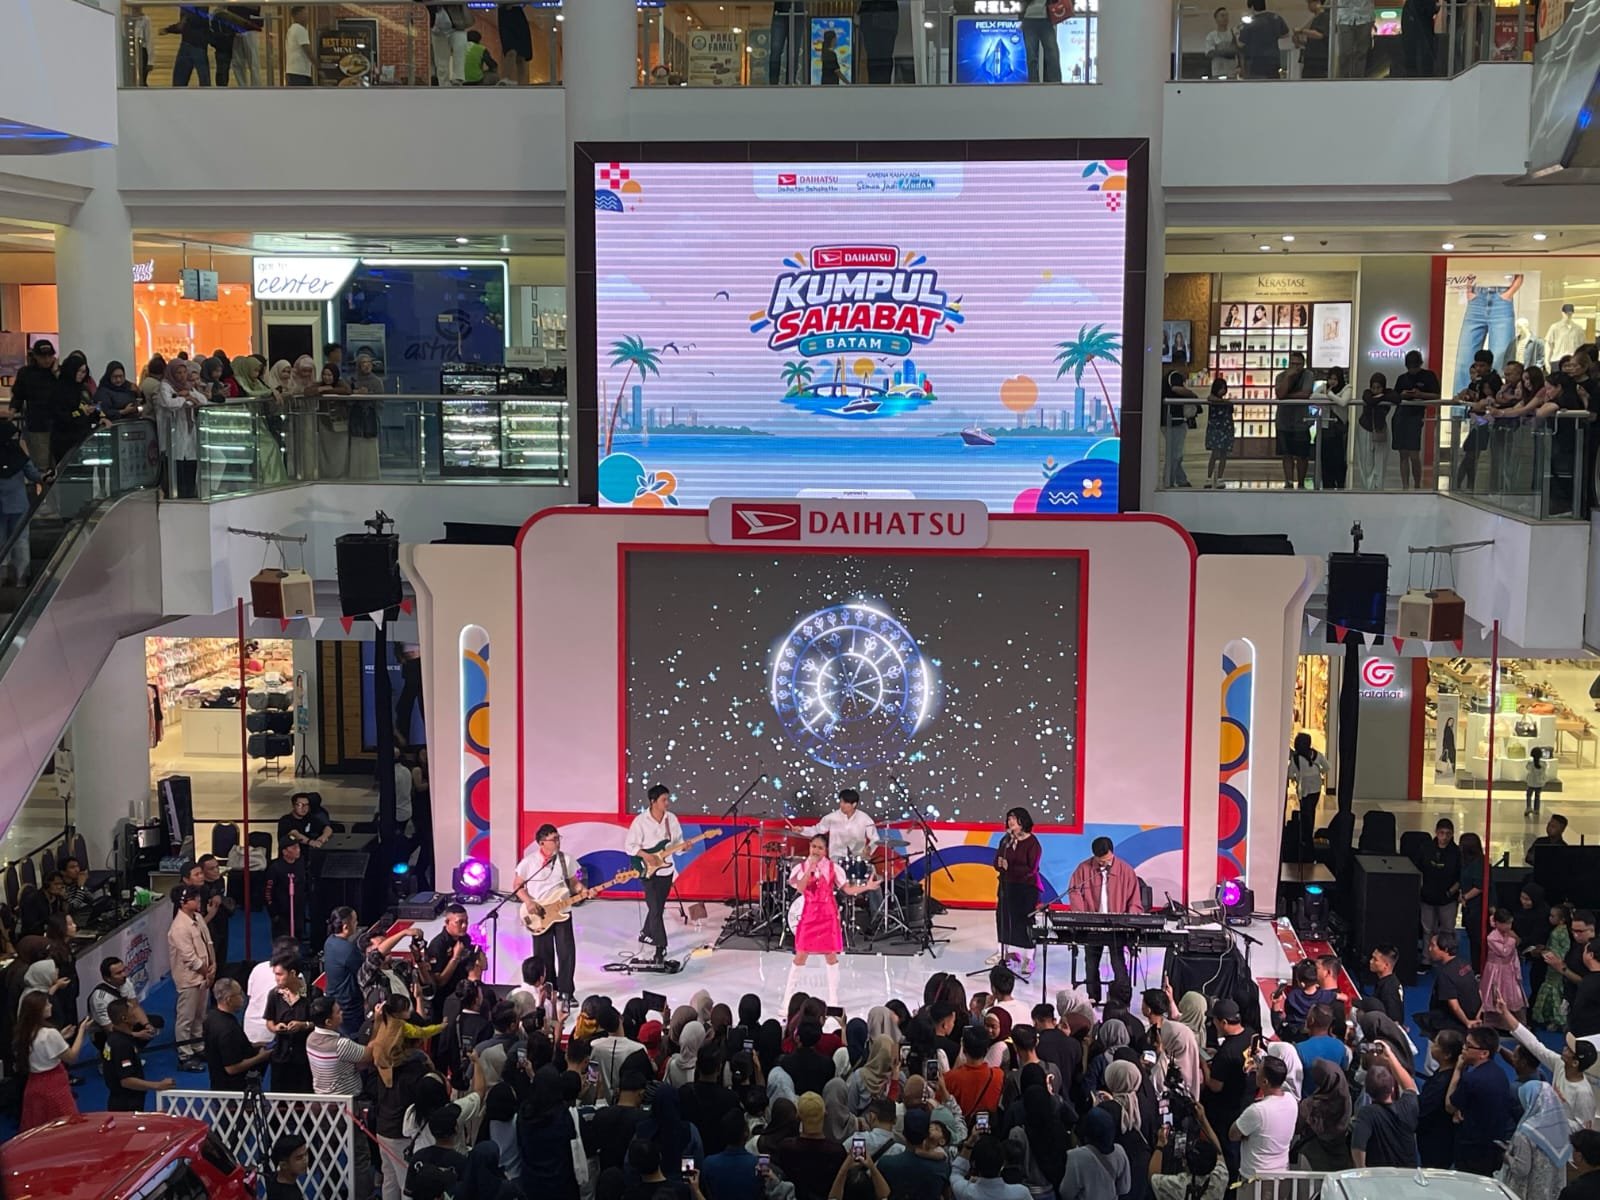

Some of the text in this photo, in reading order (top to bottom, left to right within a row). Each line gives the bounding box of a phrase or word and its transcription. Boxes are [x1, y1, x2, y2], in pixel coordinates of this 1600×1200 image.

[974, 0, 1021, 13] RELX
[709, 43, 738, 51] FAMILY
[800, 176, 839, 184] DAIHATSU
[844, 253, 892, 263] DAIHATSU
[257, 274, 334, 294] center
[772, 271, 944, 315] KUMPUL
[774, 304, 942, 344] SAHABAT
[404, 338, 462, 361] astra
[826, 338, 882, 349] BATAM
[808, 511, 966, 536] DAIHATSU
